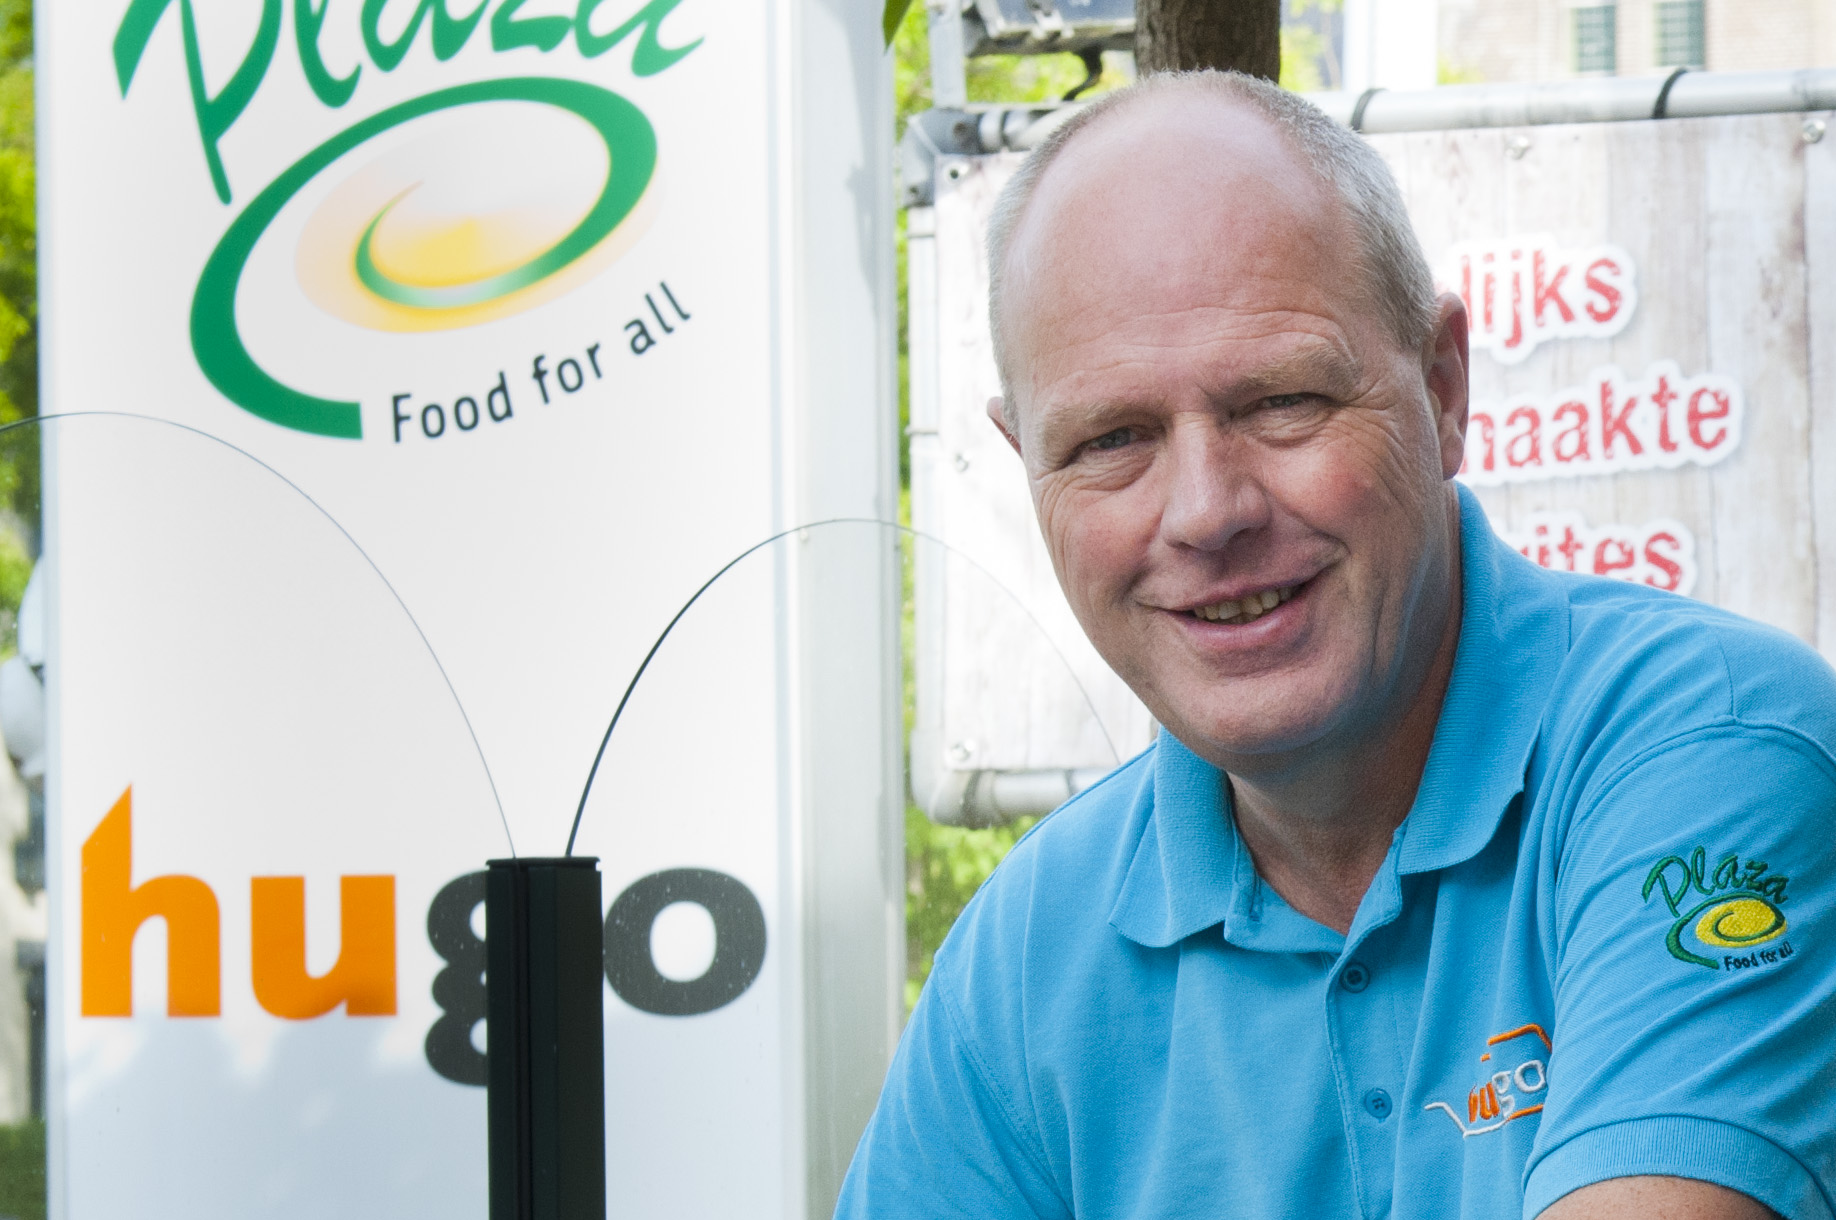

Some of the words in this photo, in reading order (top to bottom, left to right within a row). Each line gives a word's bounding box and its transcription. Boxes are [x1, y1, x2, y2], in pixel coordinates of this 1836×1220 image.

[1459, 250, 1623, 348] lijks
[391, 371, 513, 443] Food
[532, 342, 603, 405] for
[623, 281, 692, 356] all
[1641, 845, 1790, 918] Plaza
[1723, 952, 1760, 971] Food
[1760, 949, 1777, 964] for
